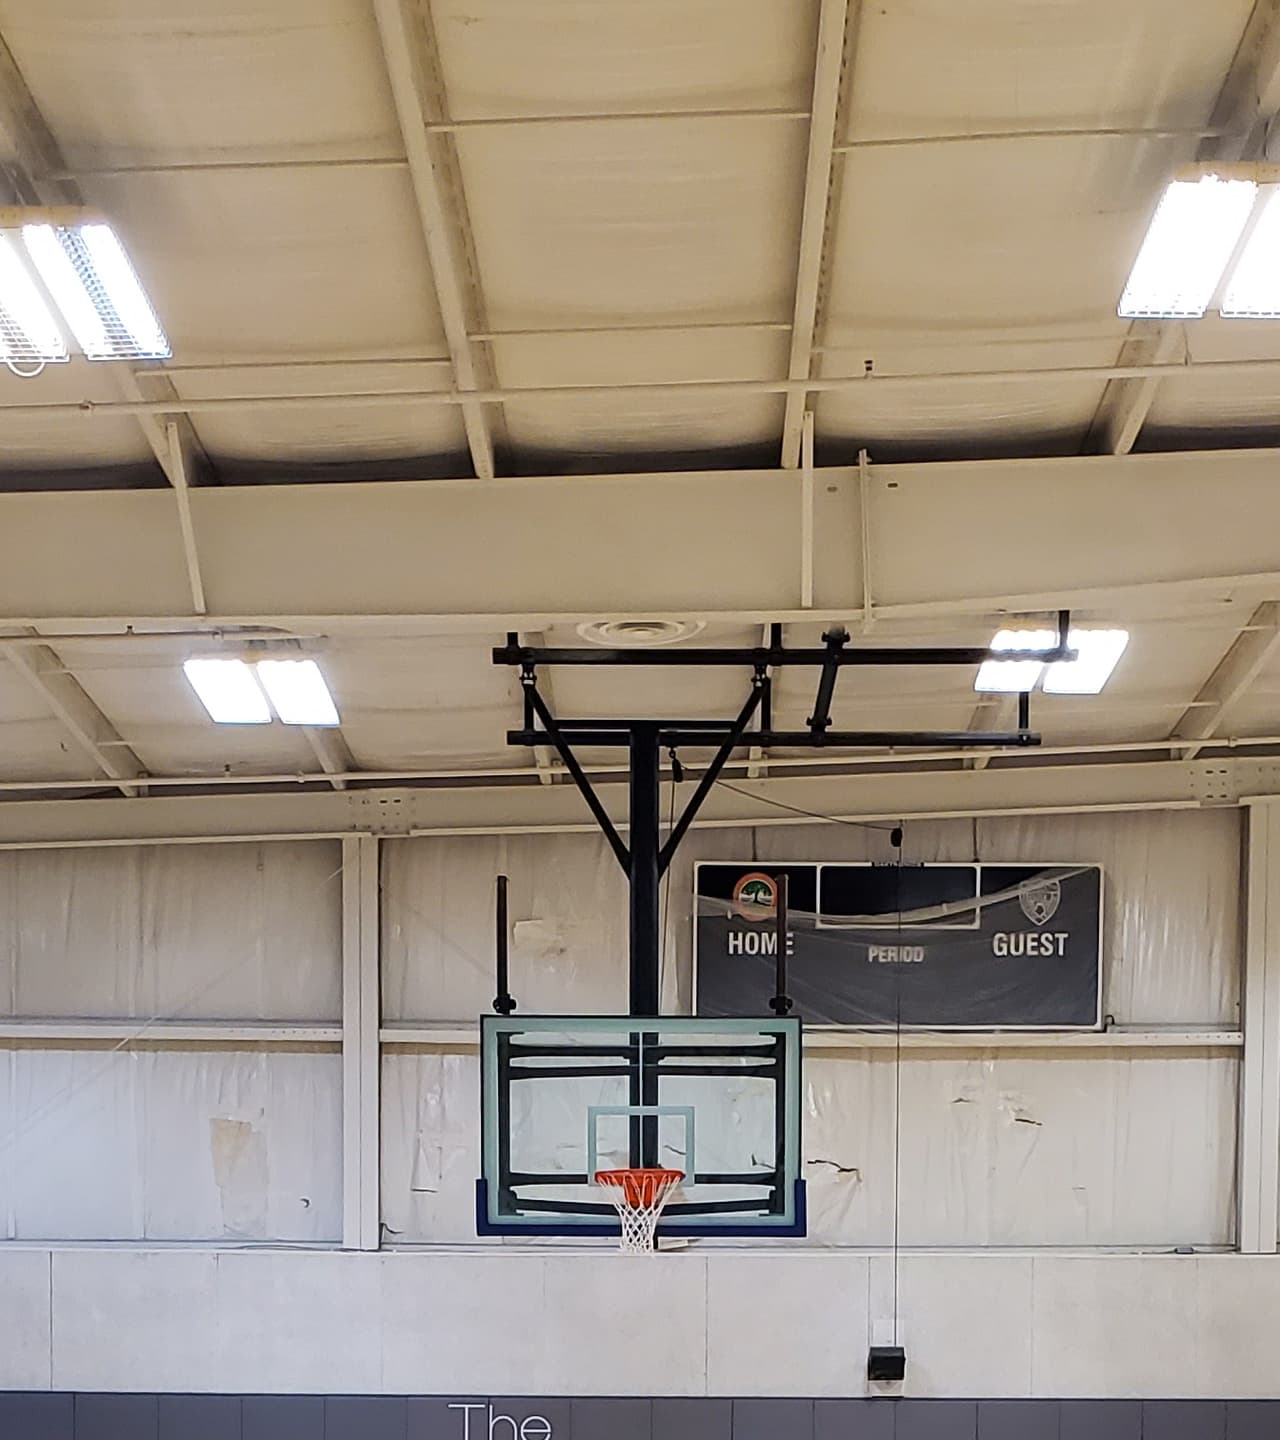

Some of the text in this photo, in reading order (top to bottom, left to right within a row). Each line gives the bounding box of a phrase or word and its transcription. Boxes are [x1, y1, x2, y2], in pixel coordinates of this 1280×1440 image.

[728, 932, 794, 955] HOME
[868, 946, 924, 963] PERIOD
[992, 932, 1069, 957] GUEST
